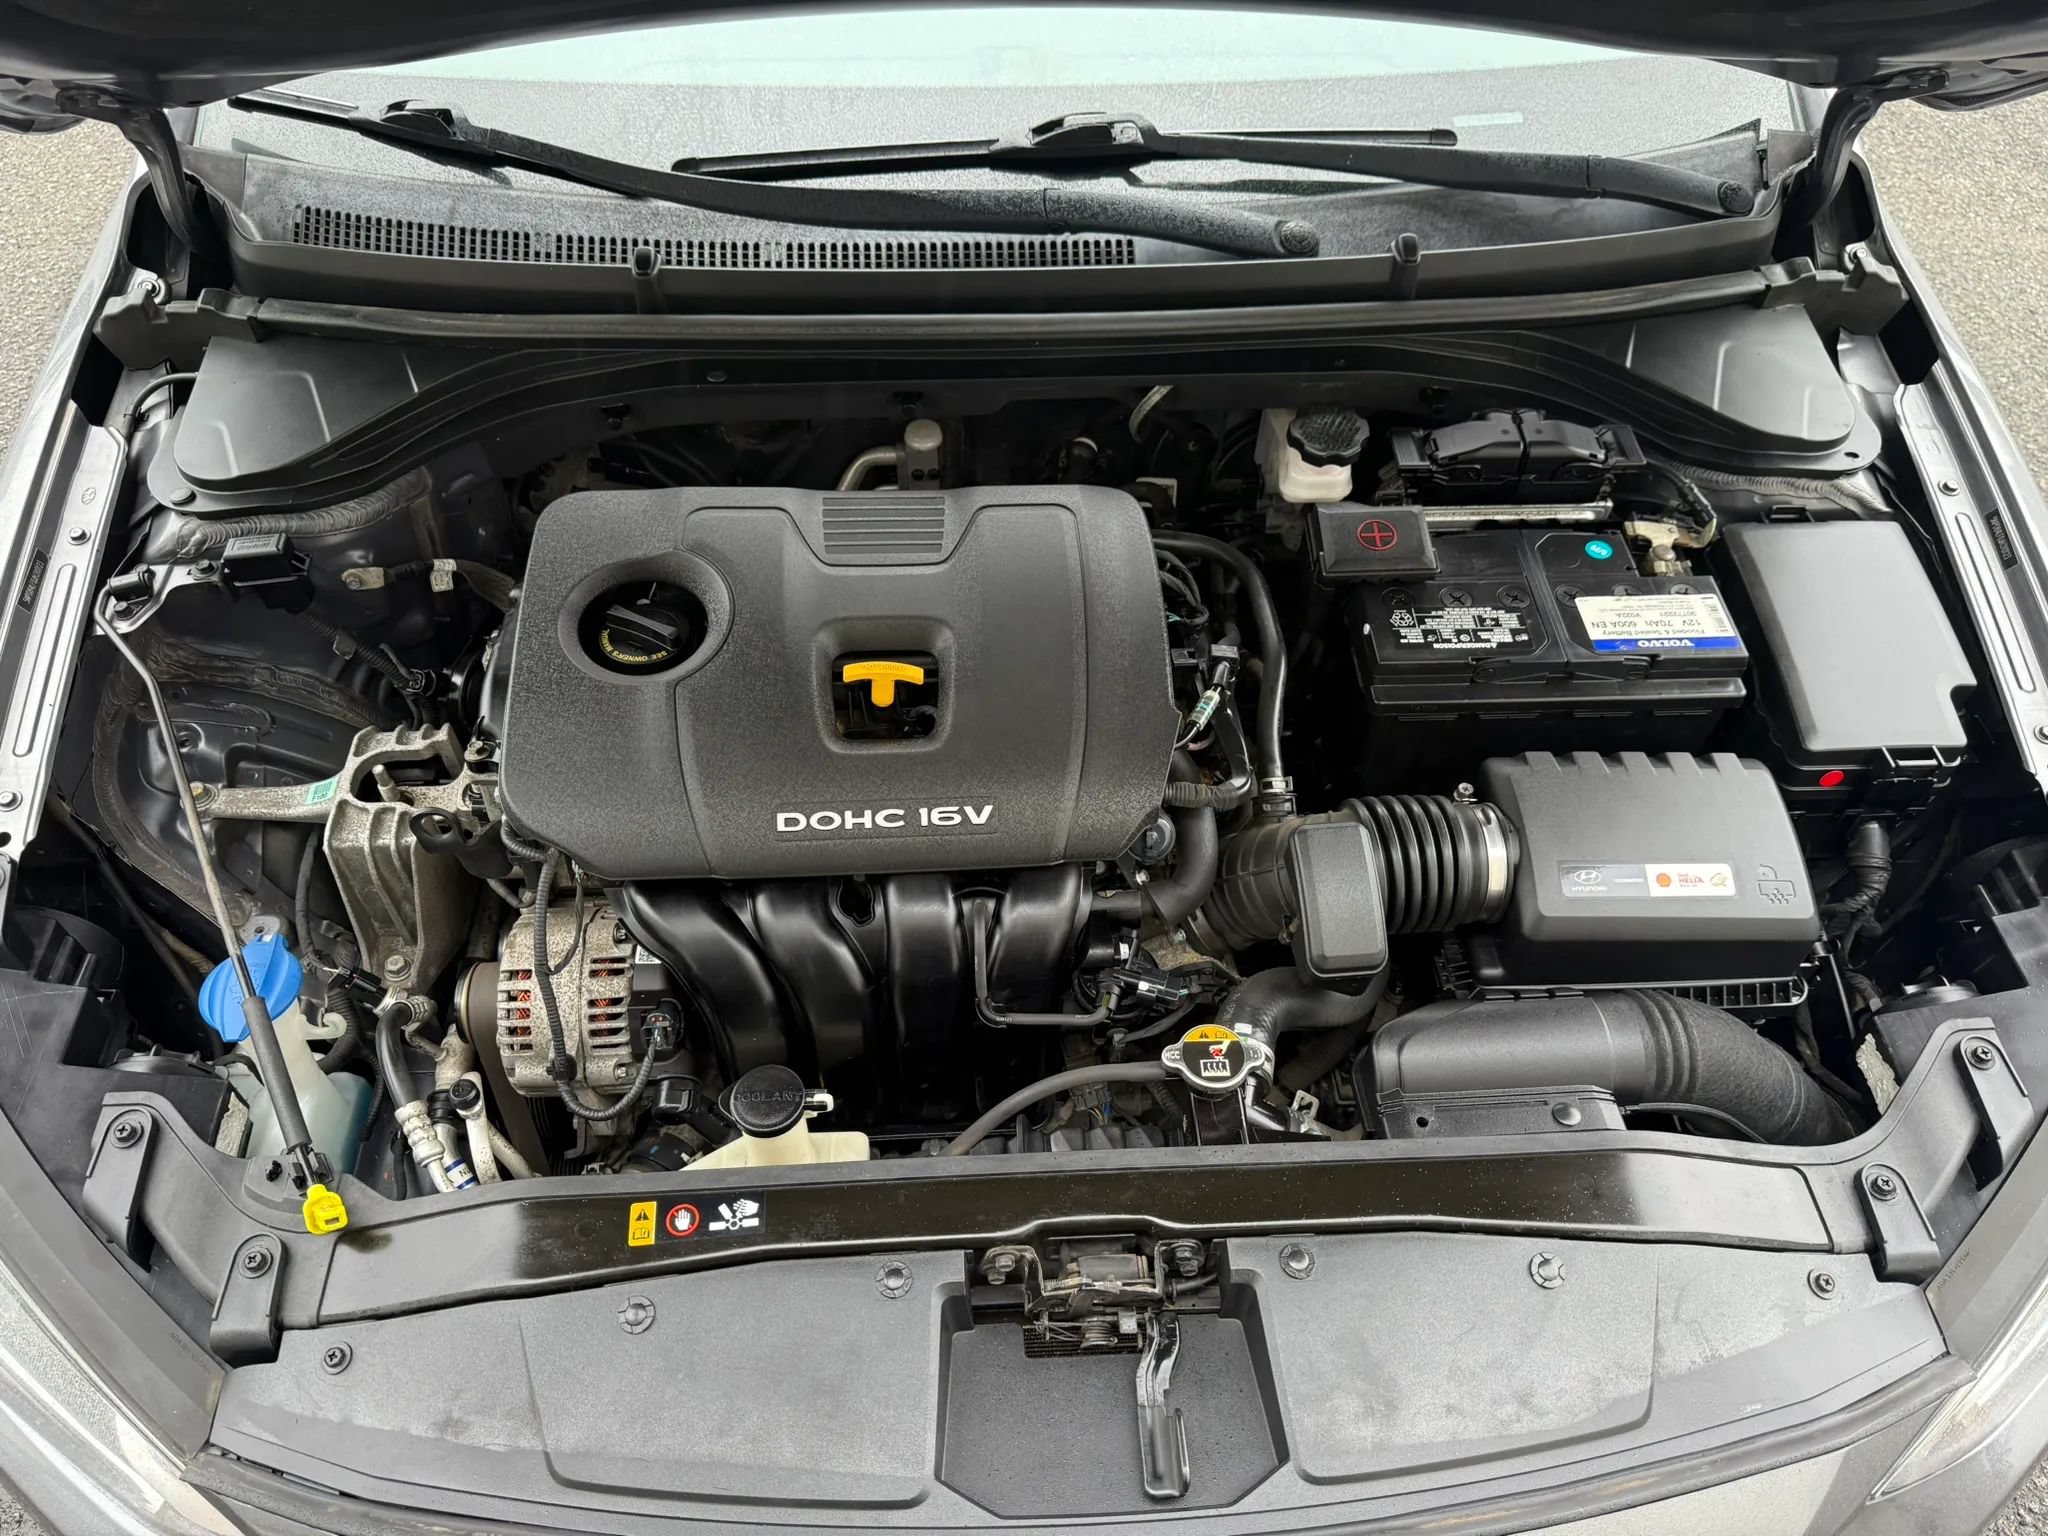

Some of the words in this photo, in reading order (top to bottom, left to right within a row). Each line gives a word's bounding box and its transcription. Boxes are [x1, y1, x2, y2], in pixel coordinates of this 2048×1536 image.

[1637, 639, 1695, 647] VOLVO
[776, 808, 906, 832] DOHC
[918, 804, 994, 827] 16V
[1164, 1050, 1181, 1060] HCC
